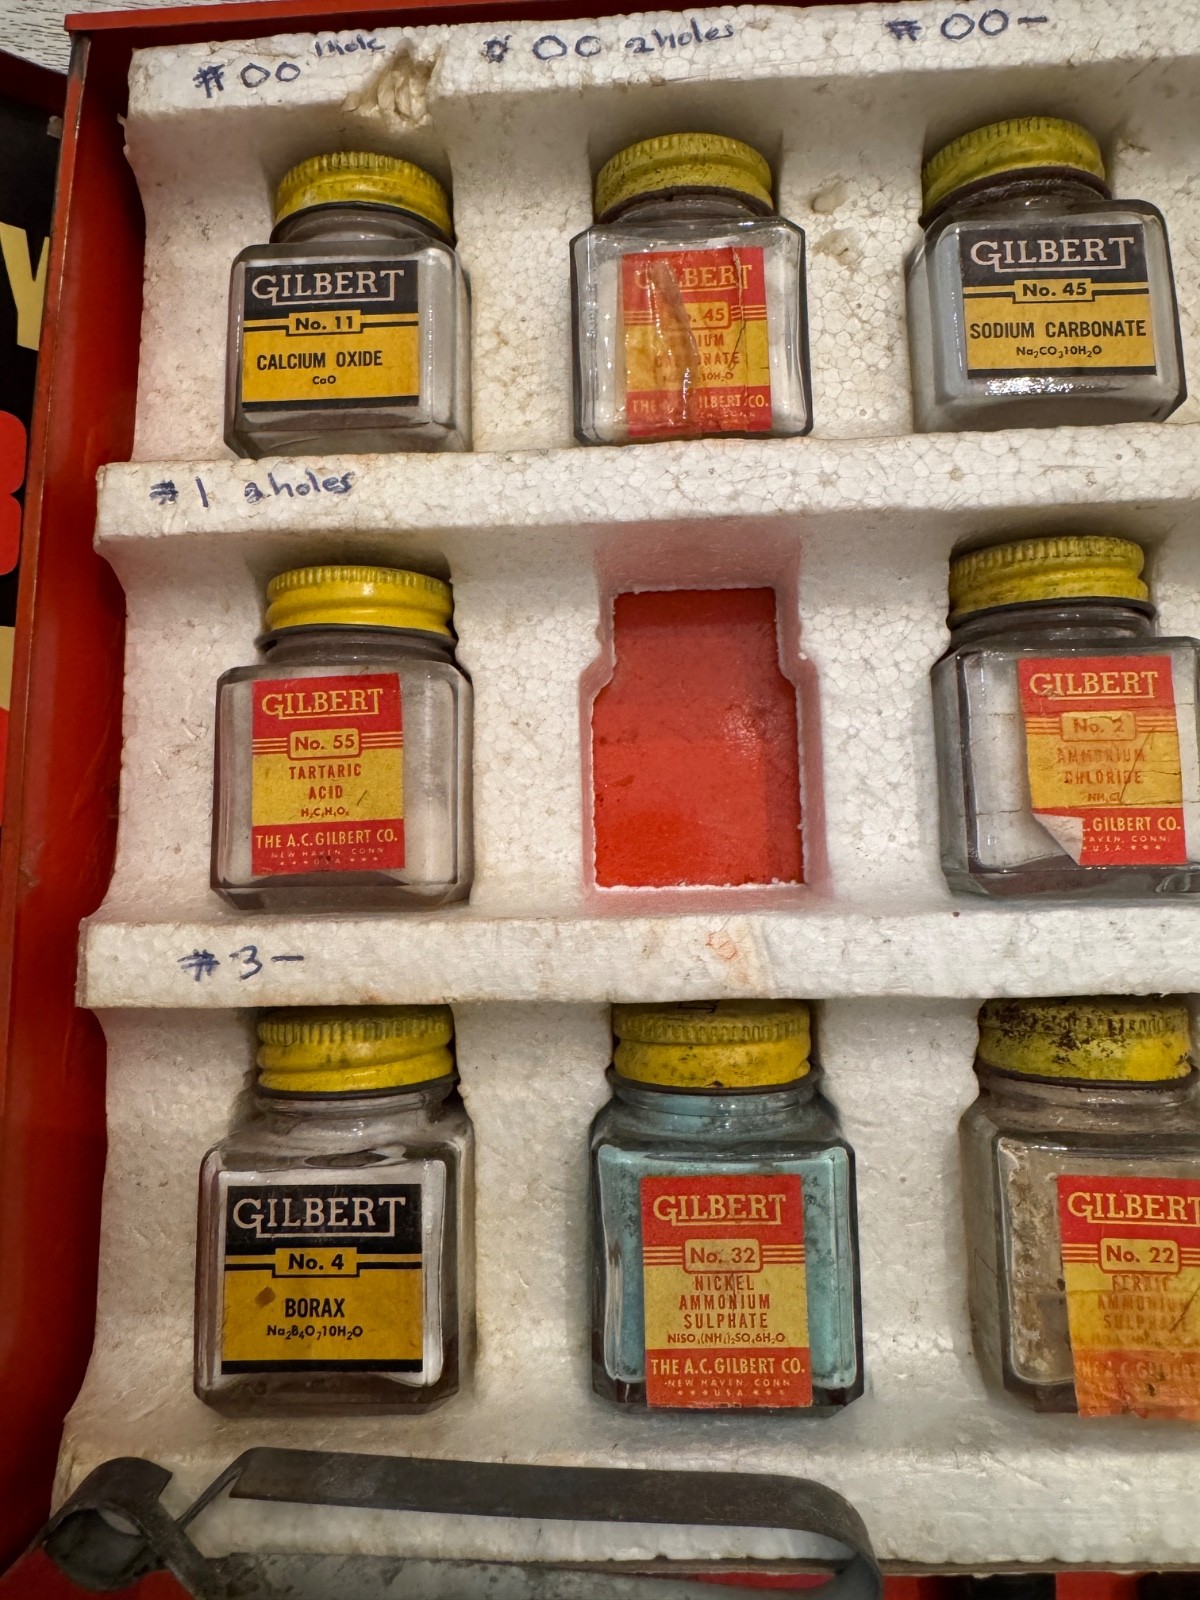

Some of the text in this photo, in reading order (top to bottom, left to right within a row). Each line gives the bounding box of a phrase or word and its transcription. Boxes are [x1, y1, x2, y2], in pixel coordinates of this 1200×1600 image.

[970, 237, 1135, 273] GILBERT
[251, 269, 405, 306] GILBERT
[1022, 282, 1088, 297] No. 45
[295, 315, 353, 331] No. 11
[703, 307, 725, 322] 45
[970, 319, 1147, 339] SODIUM CARBONATE
[256, 350, 383, 371] CALCIUM OXIDE
[312, 375, 337, 385] CaO
[1029, 671, 1158, 700] GILBERT
[261, 688, 383, 720] GILBERT
[1073, 718, 1125, 734] No. 2
[295, 734, 355, 751] No. 55
[289, 763, 362, 780] TARTARIC
[308, 785, 343, 800] ACID
[1092, 816, 1181, 832] GILBERT CO.
[256, 828, 398, 849] THE A.C. GILBERT CO.
[232, 1197, 406, 1238] GILBERT
[653, 1195, 785, 1225] GILBERT
[1067, 1191, 1200, 1227] GILBERT
[288, 1253, 344, 1270] No. 4
[690, 1248, 755, 1263] No. 32
[1106, 1245, 1175, 1264] No. 22
[694, 1275, 754, 1291] NICKEL
[284, 1298, 345, 1317] BORAX
[678, 1294, 770, 1310] AMMONIUM
[683, 1313, 768, 1329] SULPHATE
[651, 1358, 805, 1374] THE A.C. GILBERT CO.
